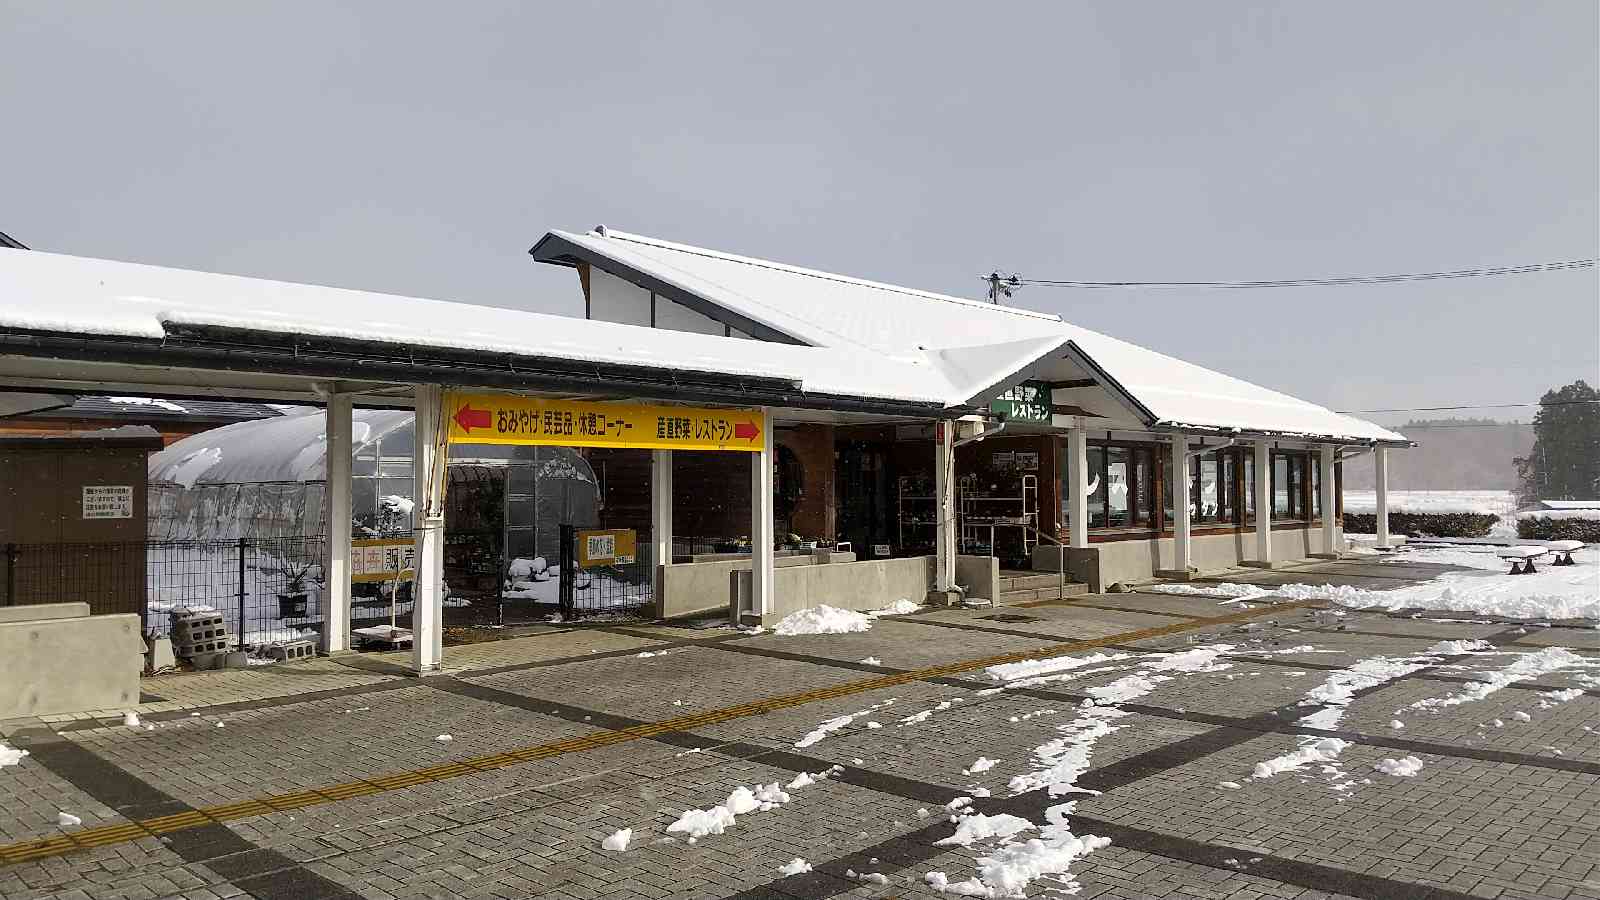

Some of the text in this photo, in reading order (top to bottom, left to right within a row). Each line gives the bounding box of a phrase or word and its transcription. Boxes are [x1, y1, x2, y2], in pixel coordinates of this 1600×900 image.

[1011, 401, 1049, 420] レストラン
